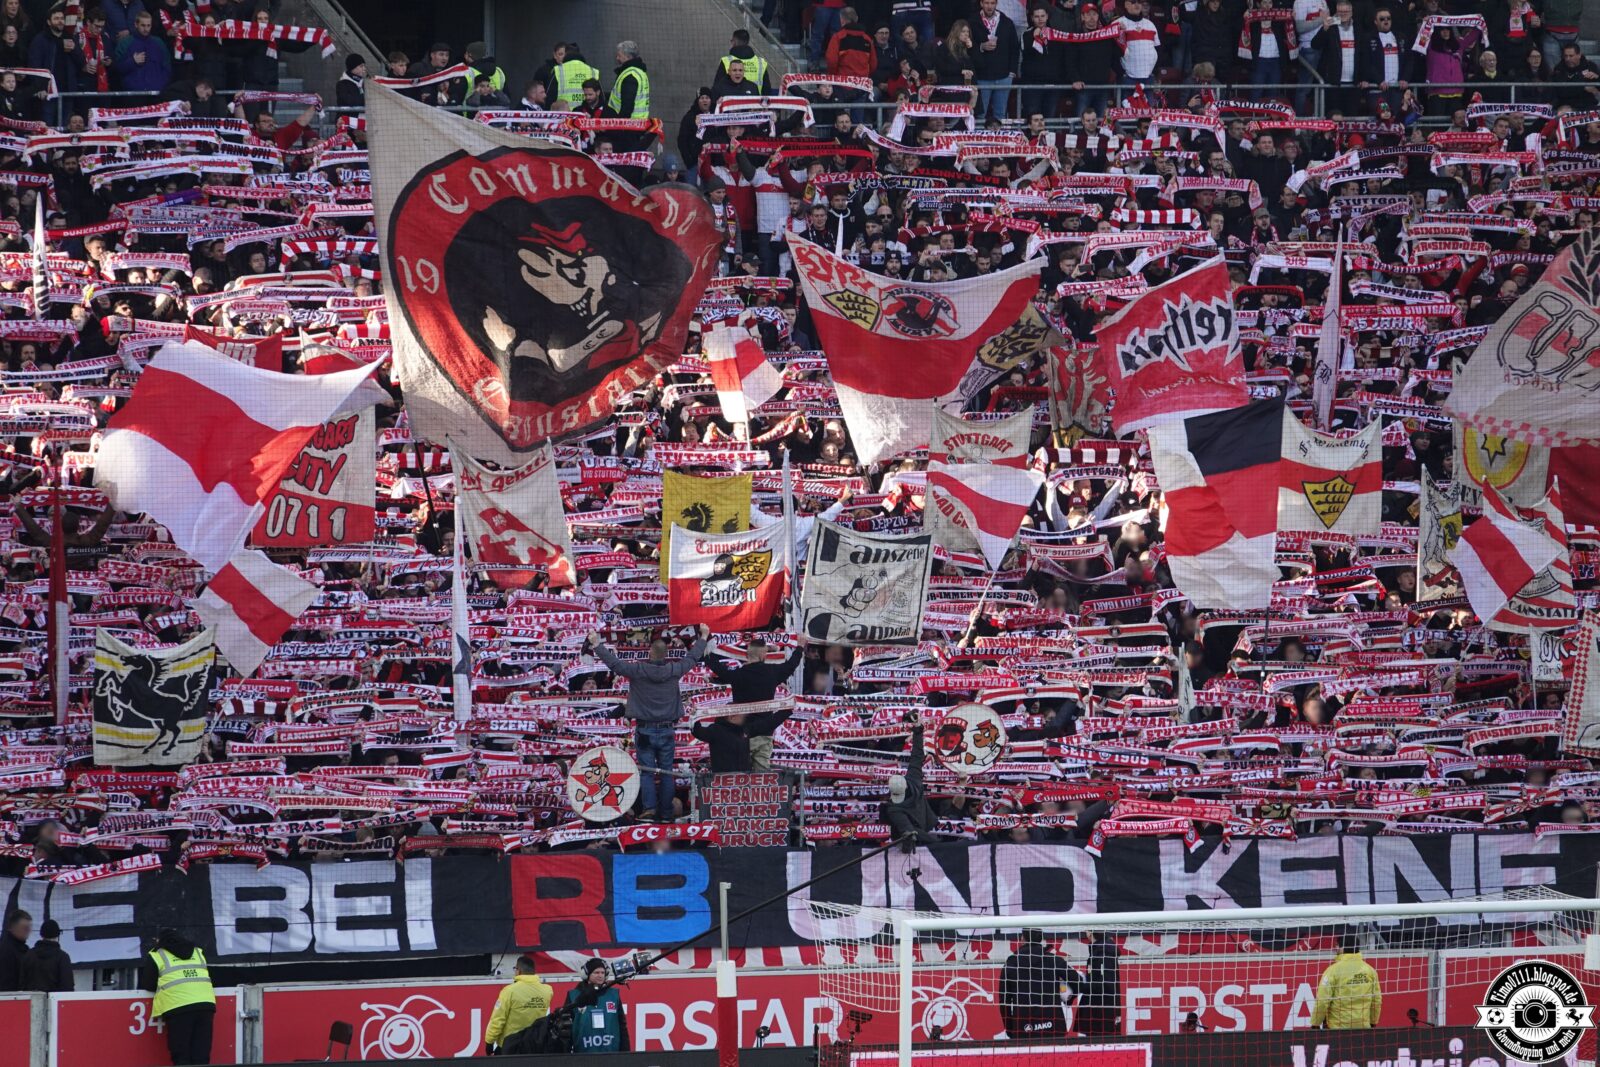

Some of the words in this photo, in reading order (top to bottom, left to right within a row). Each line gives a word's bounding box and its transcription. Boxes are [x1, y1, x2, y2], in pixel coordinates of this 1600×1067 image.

[572, 94, 586, 102] 050
[901, 103, 971, 114] STUTTGART
[1233, 101, 1290, 112] STUTTGART
[428, 162, 696, 235] Commado
[63, 221, 126, 237] DUNKELROTER
[397, 256, 440, 293] 19
[1371, 284, 1434, 300] STUTTGART
[1405, 305, 1456, 314] STUTTGART
[943, 433, 1013, 453] STUTTGART
[285, 454, 347, 495] ITY
[1063, 467, 1123, 478] STUTTGART
[804, 482, 841, 496] Ultras
[933, 491, 955, 517] AD
[266, 496, 347, 541] 0711
[872, 517, 908, 529] LEIPZIG
[1053, 548, 1095, 556] STUTTGART
[615, 592, 638, 600] VfB
[701, 585, 756, 606] Buben
[1314, 622, 1348, 633] KURVE
[966, 647, 1019, 656] STUTTGAR
[949, 675, 1014, 686] STUTTGART
[1509, 711, 1559, 719] REUTLINGEN
[490, 720, 535, 731] SZENE
[232, 744, 304, 752] CANNSTATTER
[315, 743, 347, 752] KURVE
[1061, 745, 1093, 757] SEIT
[1114, 754, 1149, 765] 1905
[1224, 761, 1300, 770] STUTTGART
[319, 767, 384, 777] ANNSTATTER
[90, 774, 116, 783] VfB
[120, 773, 177, 785] Stuttgart
[712, 773, 778, 786] JEDER
[701, 786, 788, 804] VERBANNTE
[711, 804, 780, 817] KEHRT
[984, 818, 1015, 826] COMM
[1035, 815, 1065, 824] ANDO
[632, 827, 659, 840] CC
[687, 825, 714, 837] 97
[1231, 824, 1247, 832] CC
[1269, 826, 1284, 834] 97
[707, 831, 788, 847] URÜCK
[0, 876, 141, 967] IE
[209, 857, 437, 956] BEI
[511, 851, 711, 948] RB
[786, 843, 1098, 945] UND
[1158, 833, 1561, 935] KEINE
[129, 1002, 164, 1036] 34
[1034, 1021, 1053, 1031] JAKO
[583, 1034, 614, 1048] HOST
